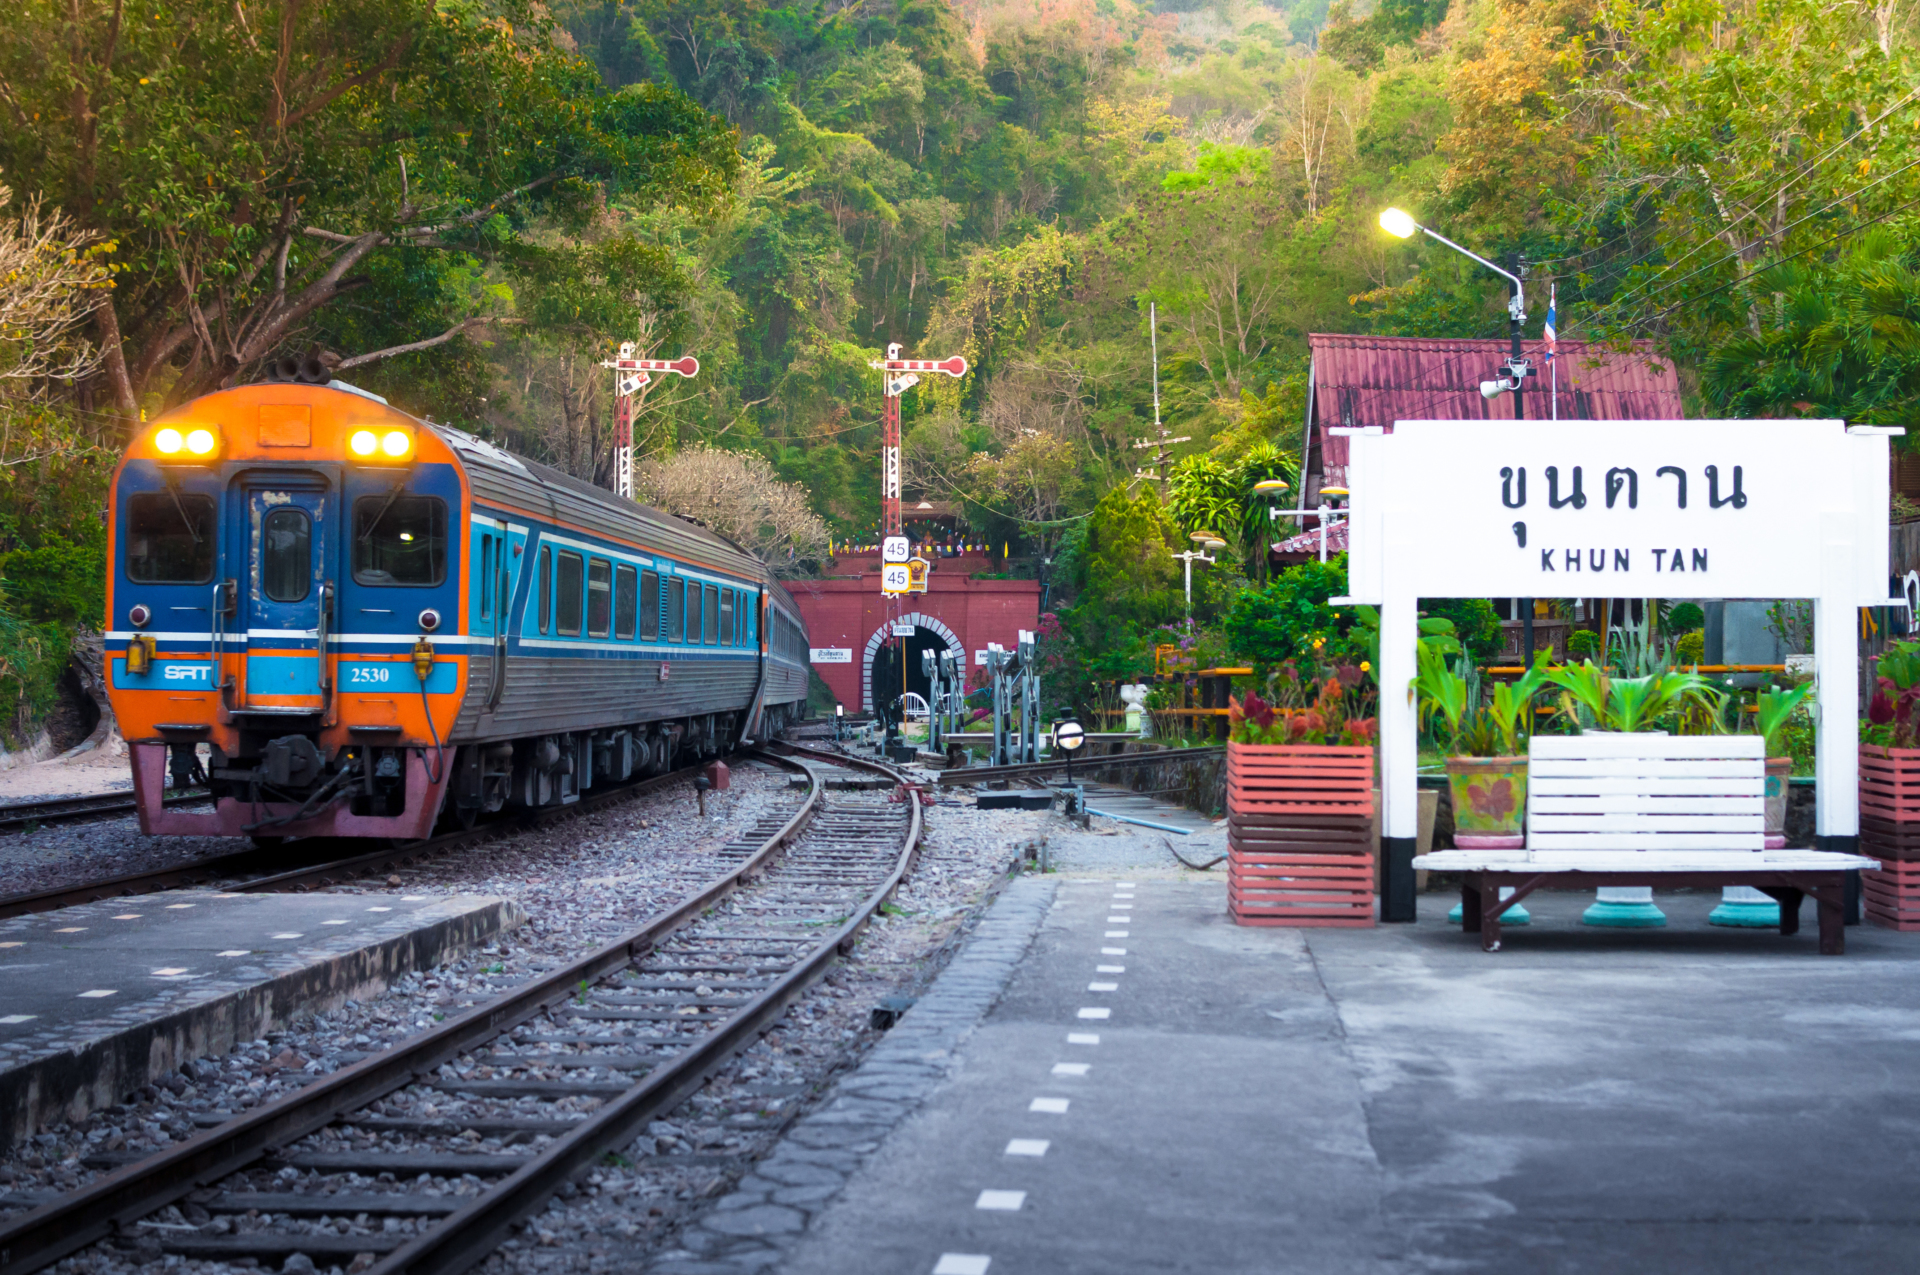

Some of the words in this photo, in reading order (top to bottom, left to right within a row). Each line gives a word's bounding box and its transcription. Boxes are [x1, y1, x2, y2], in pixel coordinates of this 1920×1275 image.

[1499, 465, 1747, 548] ขุนตาน
[887, 543, 905, 555] 45
[1541, 548, 1629, 572] KHUN
[1651, 548, 1707, 572] TAN
[887, 572, 905, 584] 45
[164, 666, 211, 680] SRT
[351, 668, 389, 682] 2530
